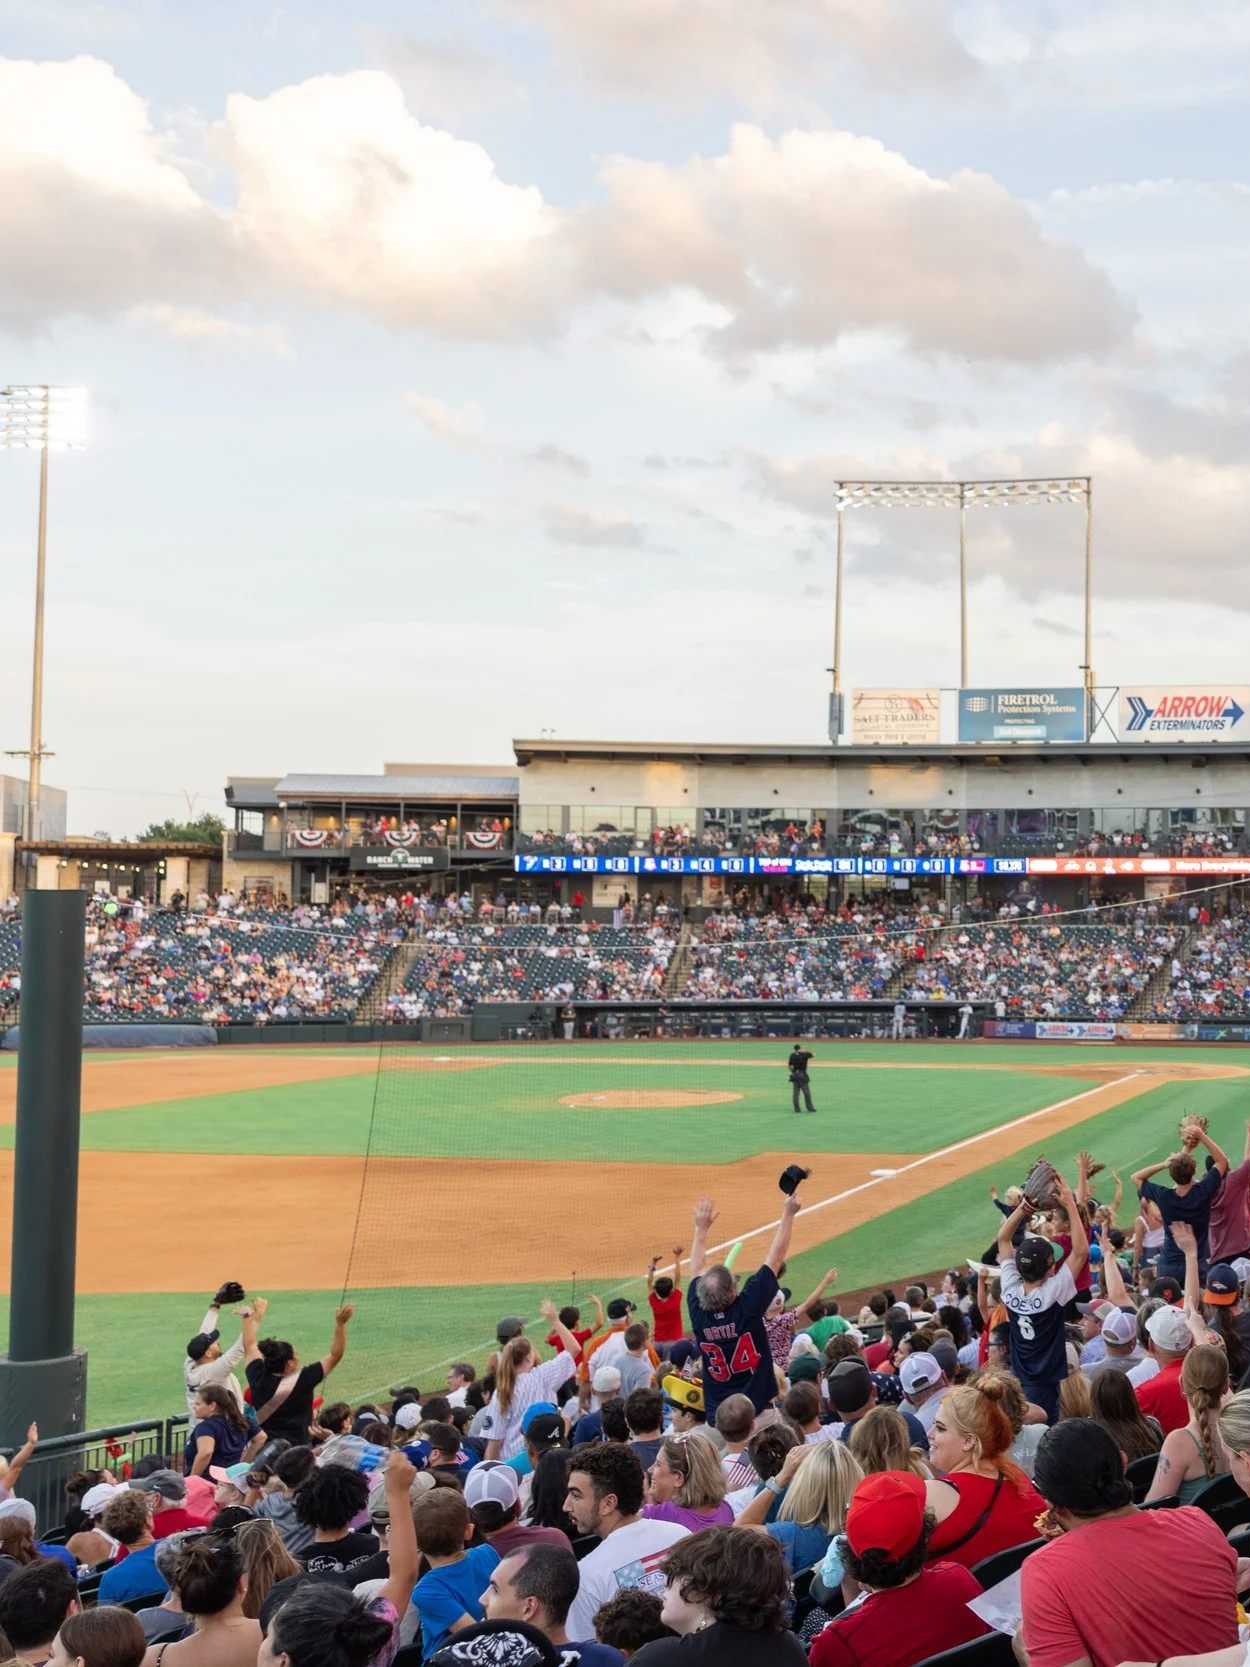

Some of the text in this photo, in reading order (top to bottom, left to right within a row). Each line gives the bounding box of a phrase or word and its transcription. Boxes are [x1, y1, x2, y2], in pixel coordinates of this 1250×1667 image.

[997, 694, 1058, 705] FIRETROL
[1153, 695, 1229, 718] ARROW
[884, 712, 936, 722] TRADERS
[997, 705, 1077, 715] Protection Systems
[1149, 719, 1227, 731] EXTERMINATORS
[703, 1323, 738, 1341] ORTIZ
[1017, 1315, 1035, 1341] 6
[700, 1331, 761, 1383] 34
